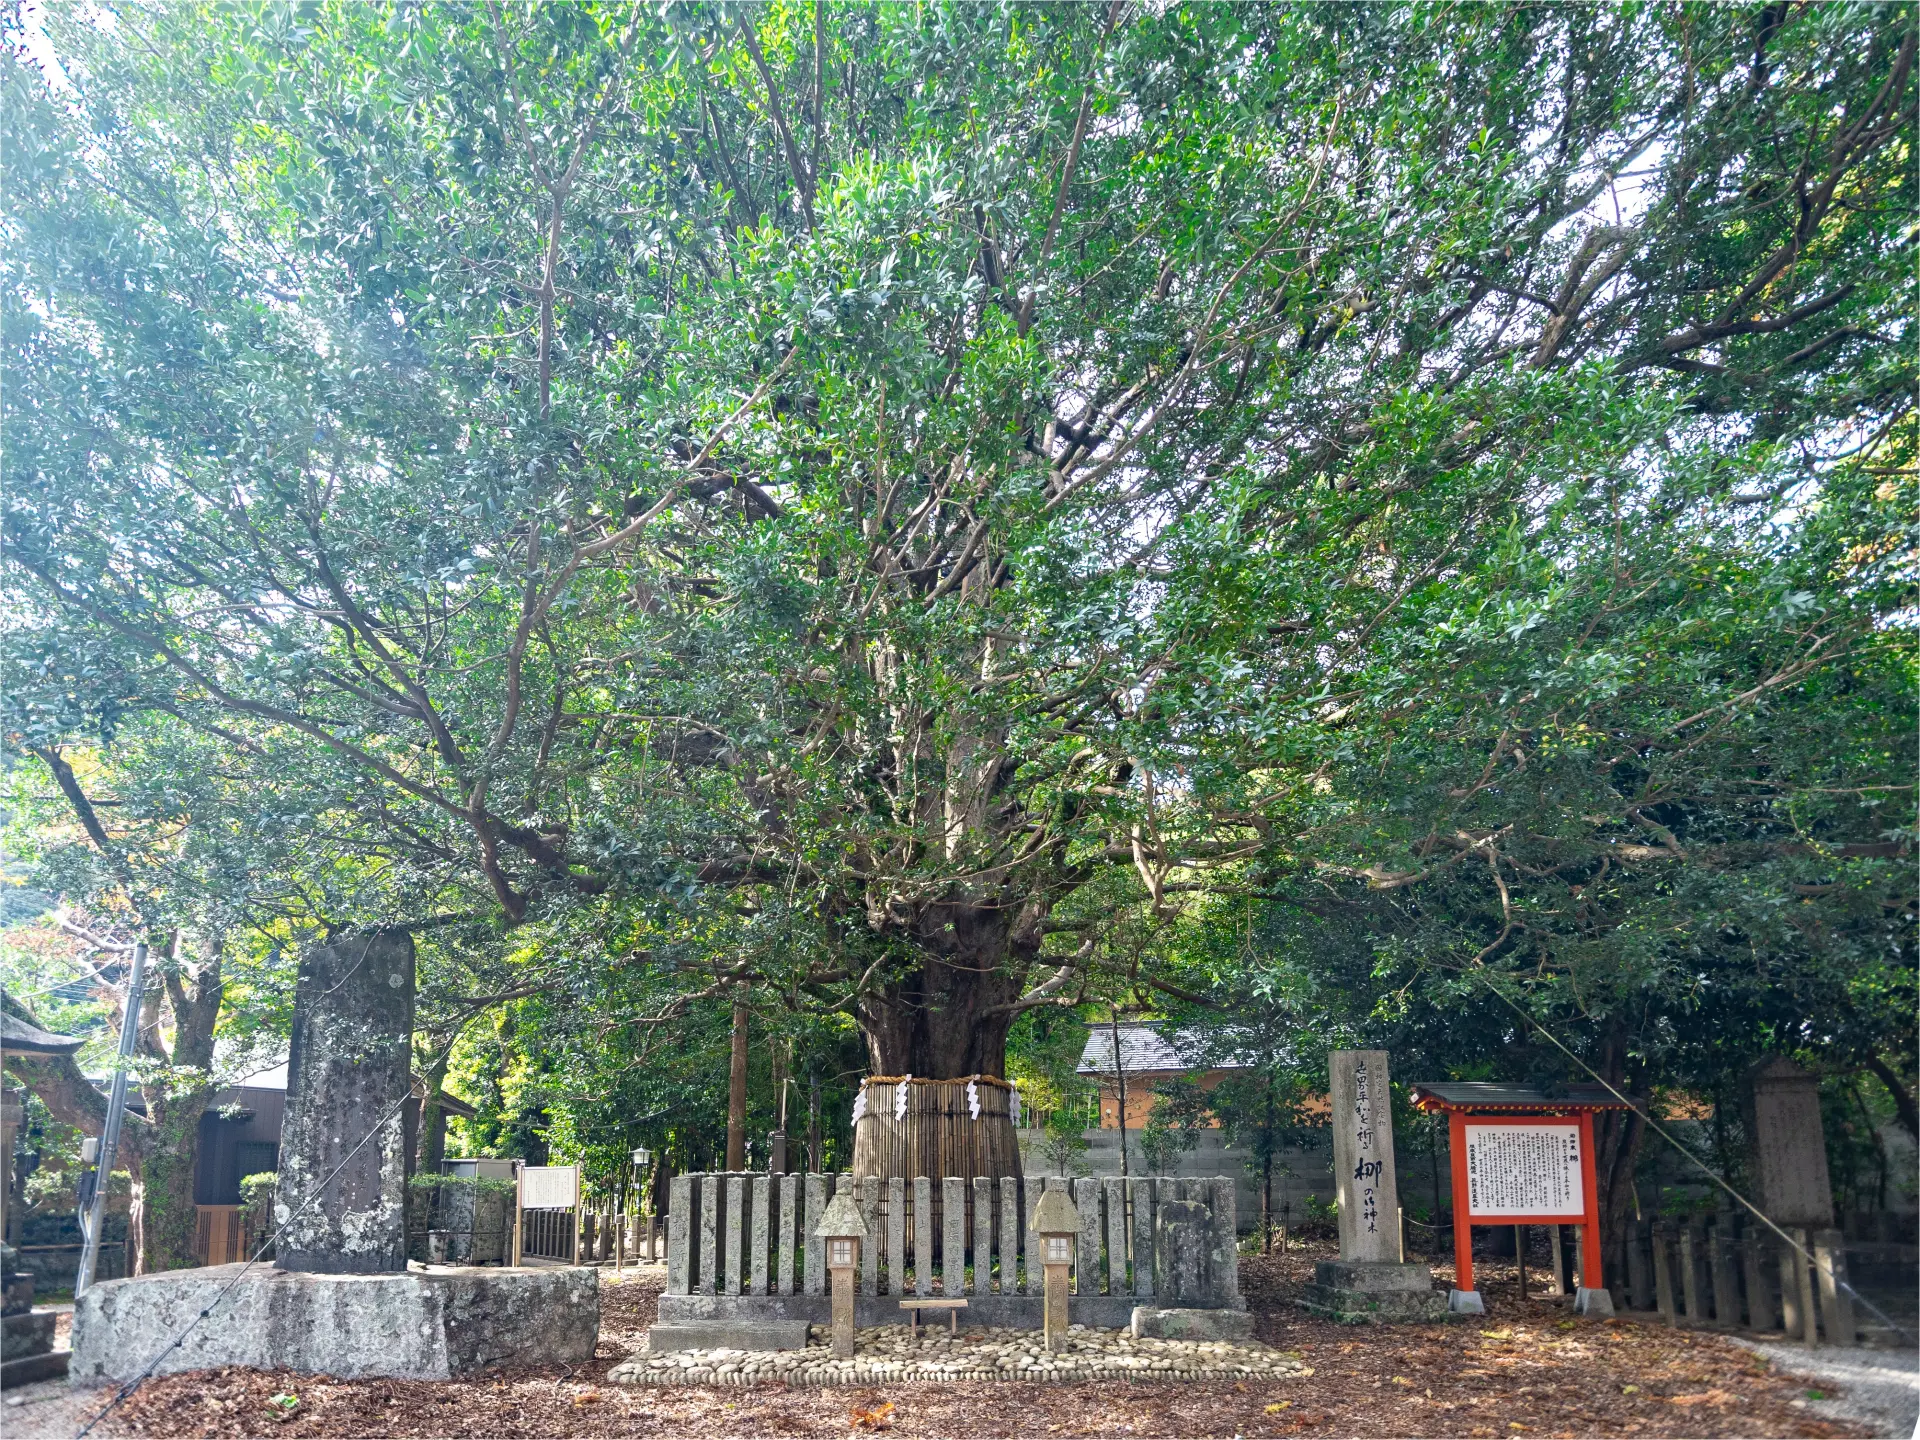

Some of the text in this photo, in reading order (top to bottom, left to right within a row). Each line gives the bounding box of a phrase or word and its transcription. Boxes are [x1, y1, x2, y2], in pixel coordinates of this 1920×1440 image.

[1471, 1178, 1479, 1208] 熊野速玉大社
